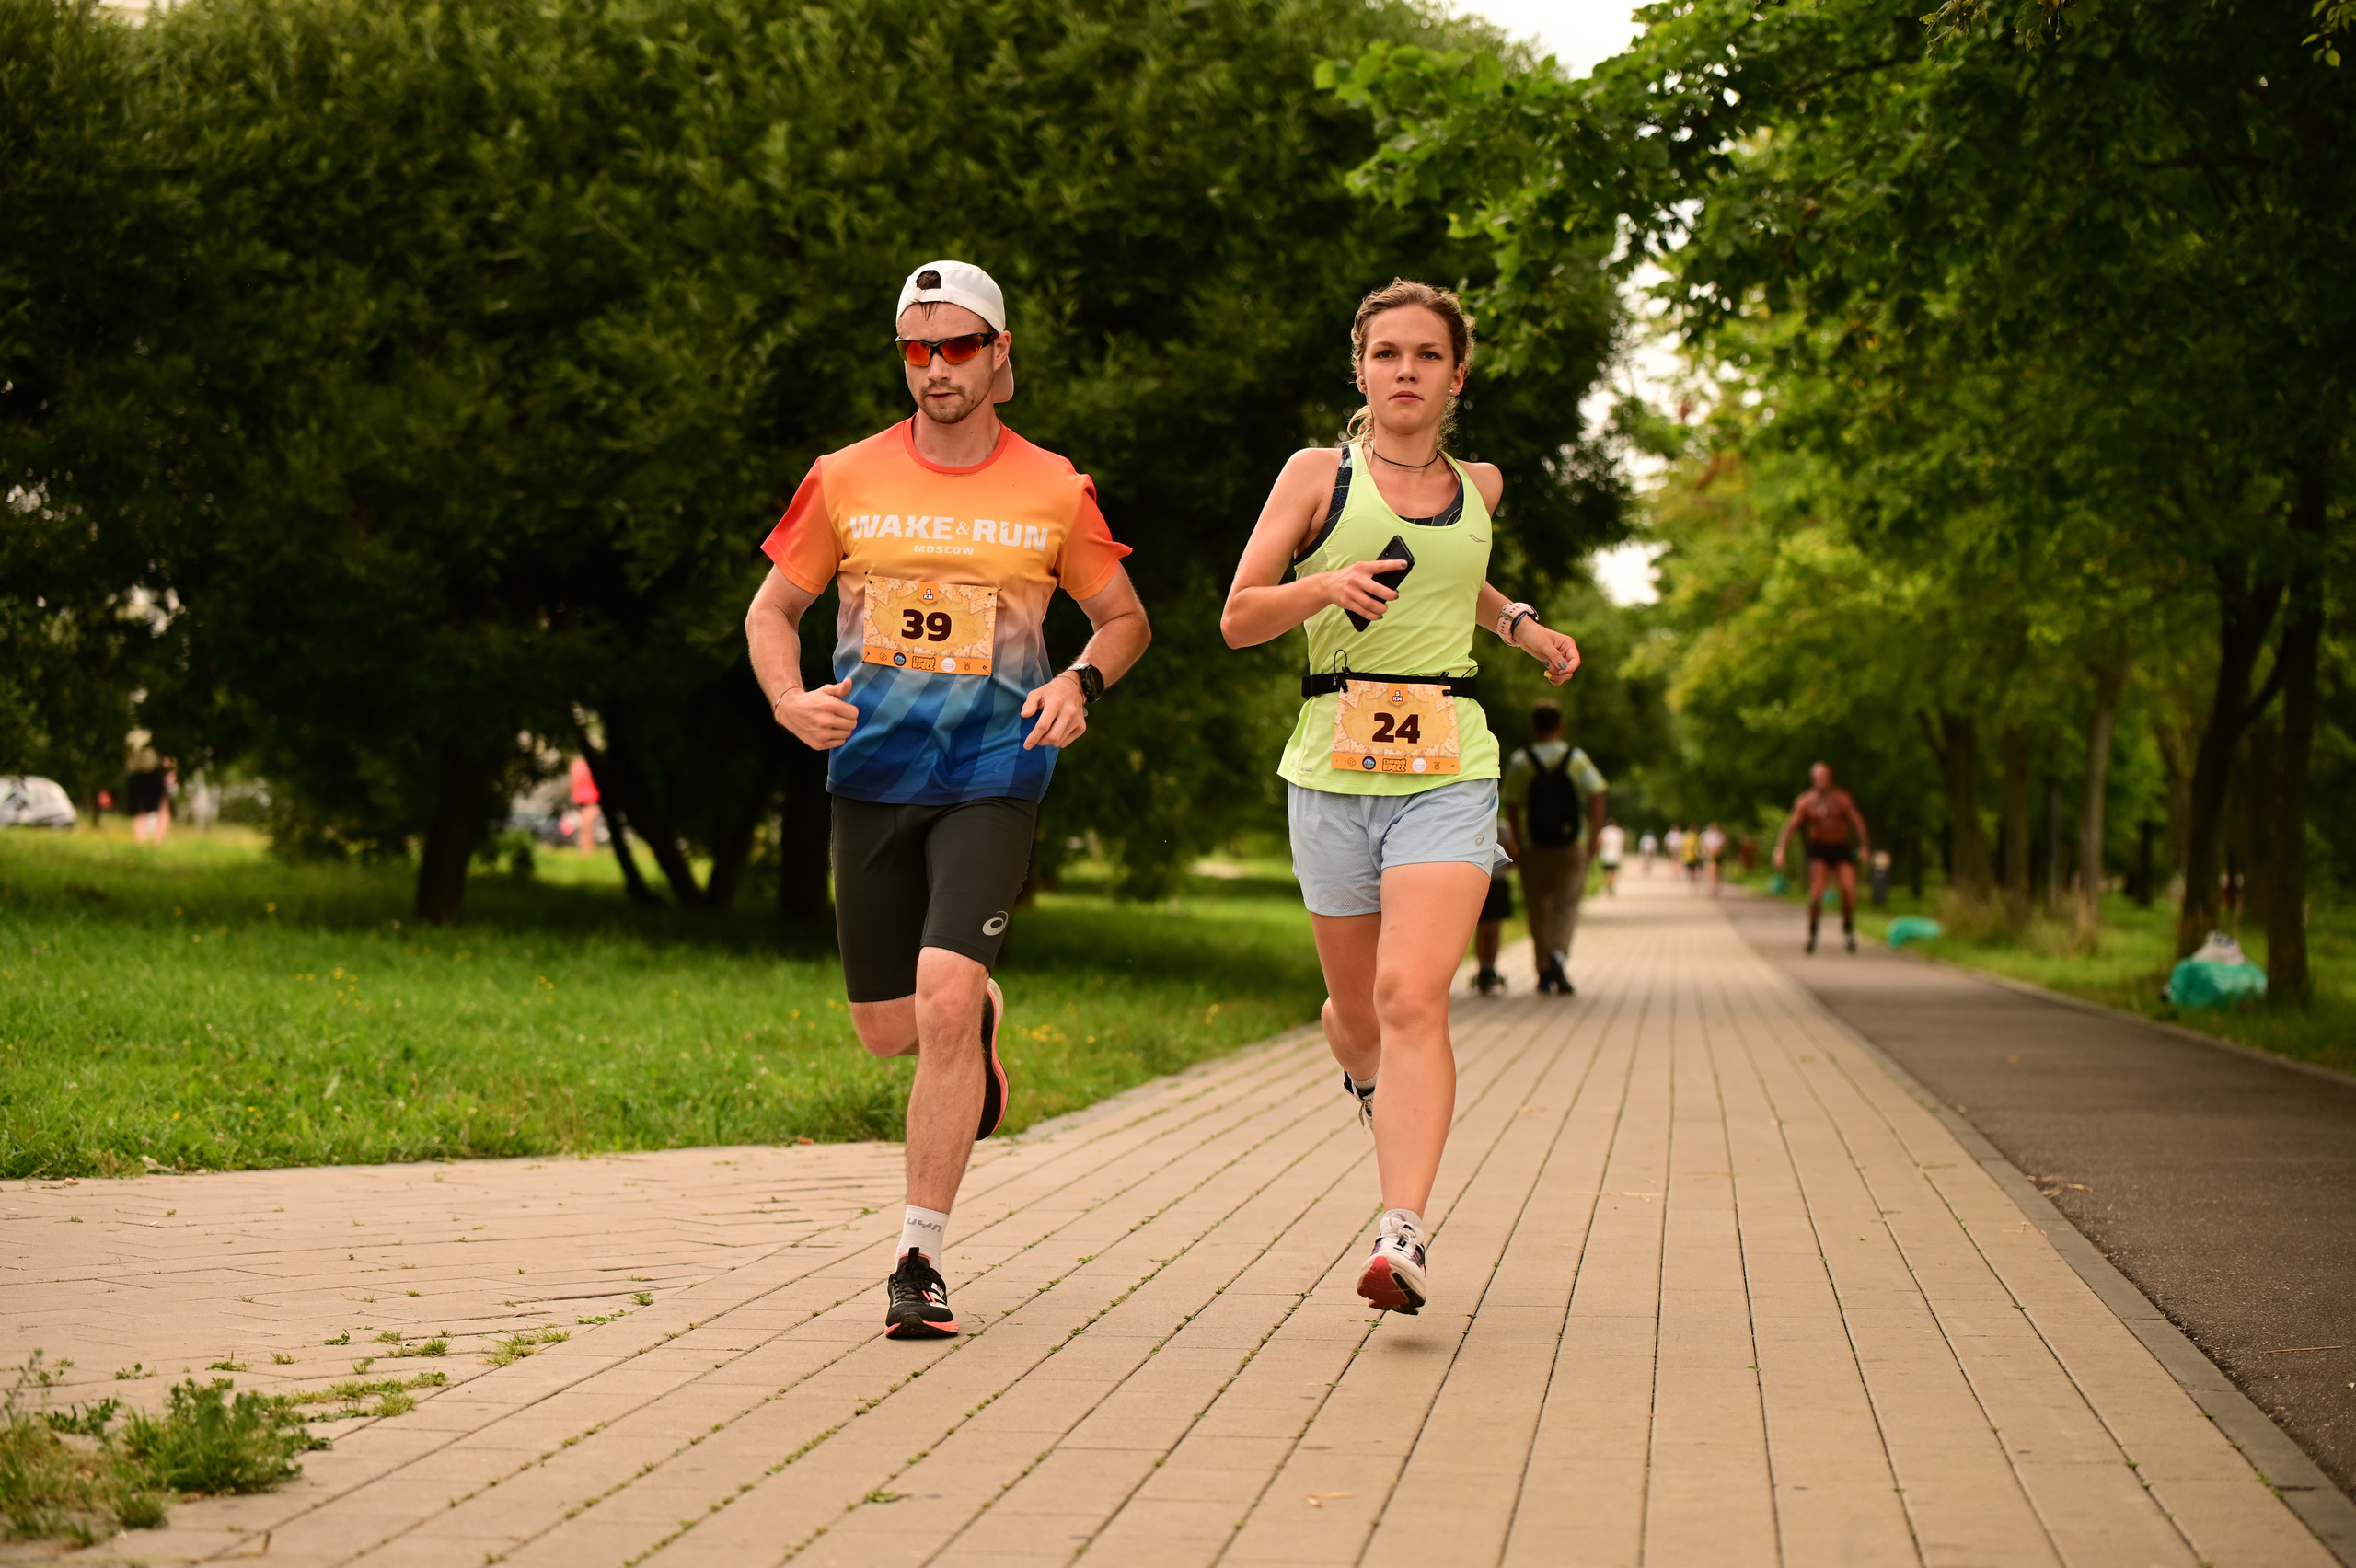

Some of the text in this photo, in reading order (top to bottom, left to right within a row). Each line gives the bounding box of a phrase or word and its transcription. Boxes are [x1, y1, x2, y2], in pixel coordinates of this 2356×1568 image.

[914, 545, 974, 556] MOSCOW
[901, 608, 952, 641] 39
[1372, 712, 1420, 744] 24
